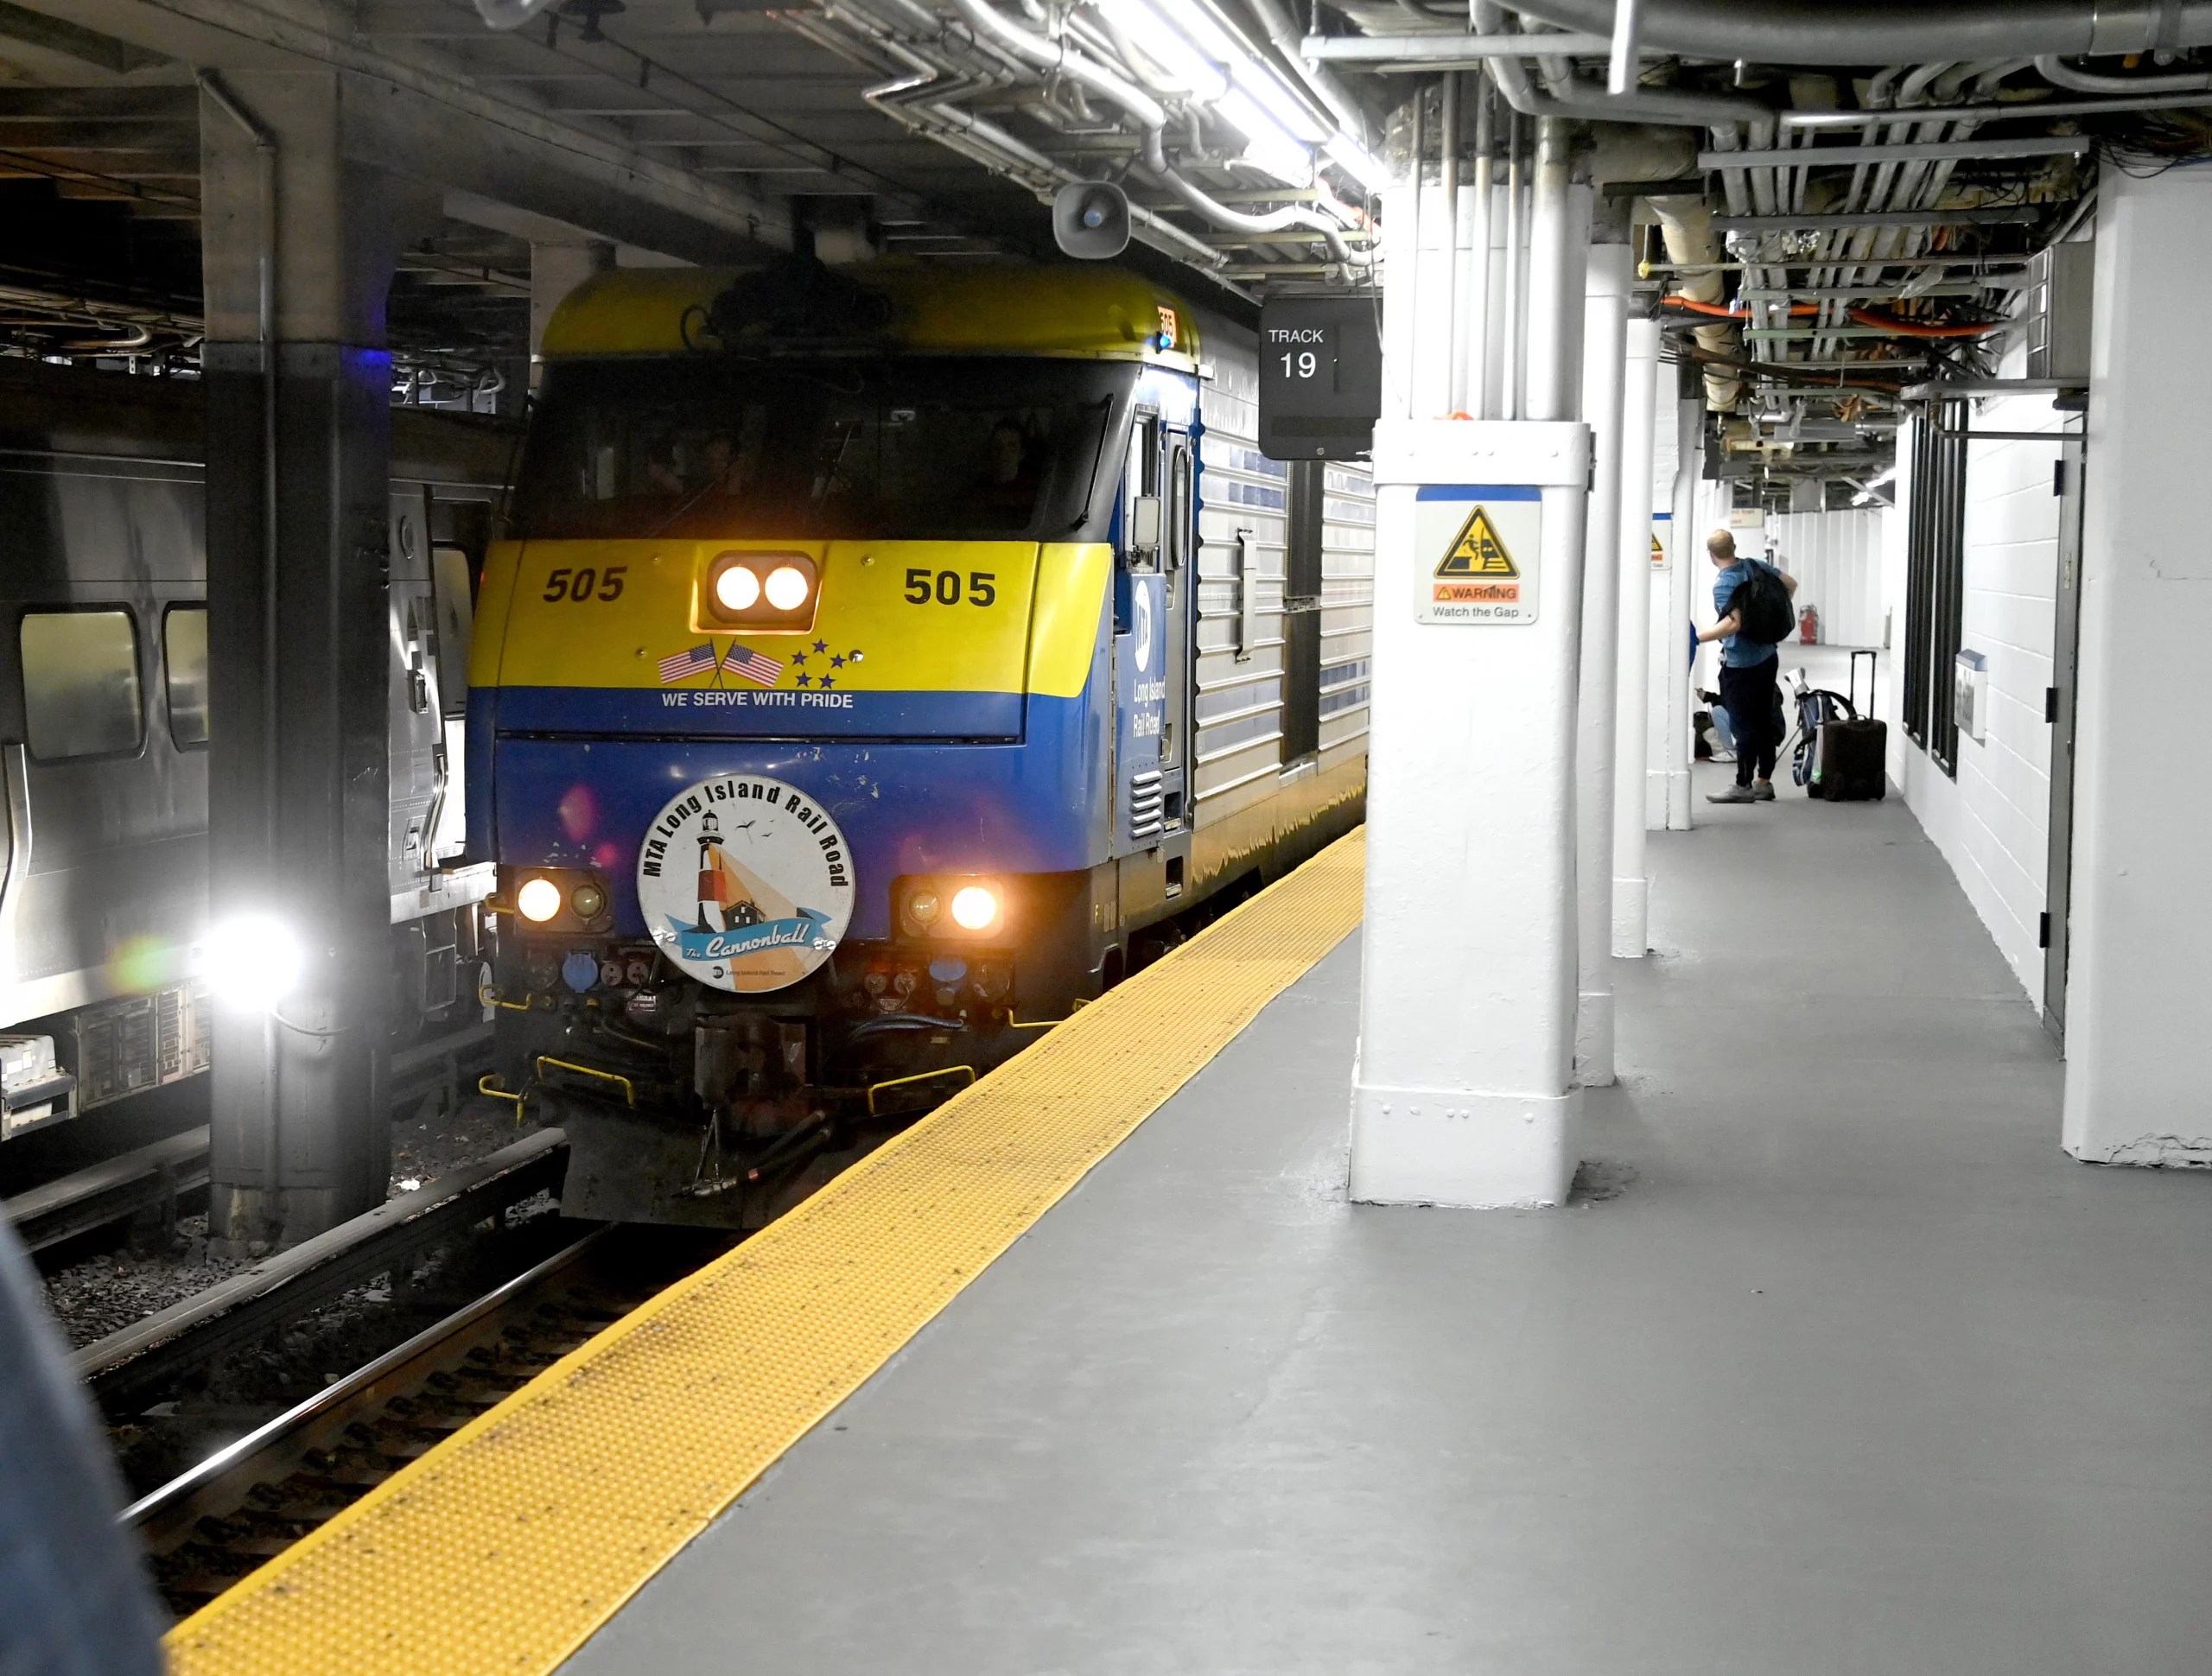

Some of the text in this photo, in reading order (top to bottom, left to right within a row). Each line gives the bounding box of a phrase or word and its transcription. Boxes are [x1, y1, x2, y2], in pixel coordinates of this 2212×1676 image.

[1268, 329, 1324, 343] TRACK
[1280, 352, 1317, 378] 19
[543, 566, 628, 603] 505
[904, 568, 996, 607] 505
[1452, 587, 1516, 600] WARNING
[1433, 606, 1519, 619] Watch the Gap
[662, 692, 854, 708] WE SERVE WITH PRIDE
[1134, 676, 1166, 708] Long Island
[1133, 708, 1160, 738] Rail Road
[643, 780, 849, 887] MTA Long Island Rail Road
[686, 923, 810, 958] The Cannonball
